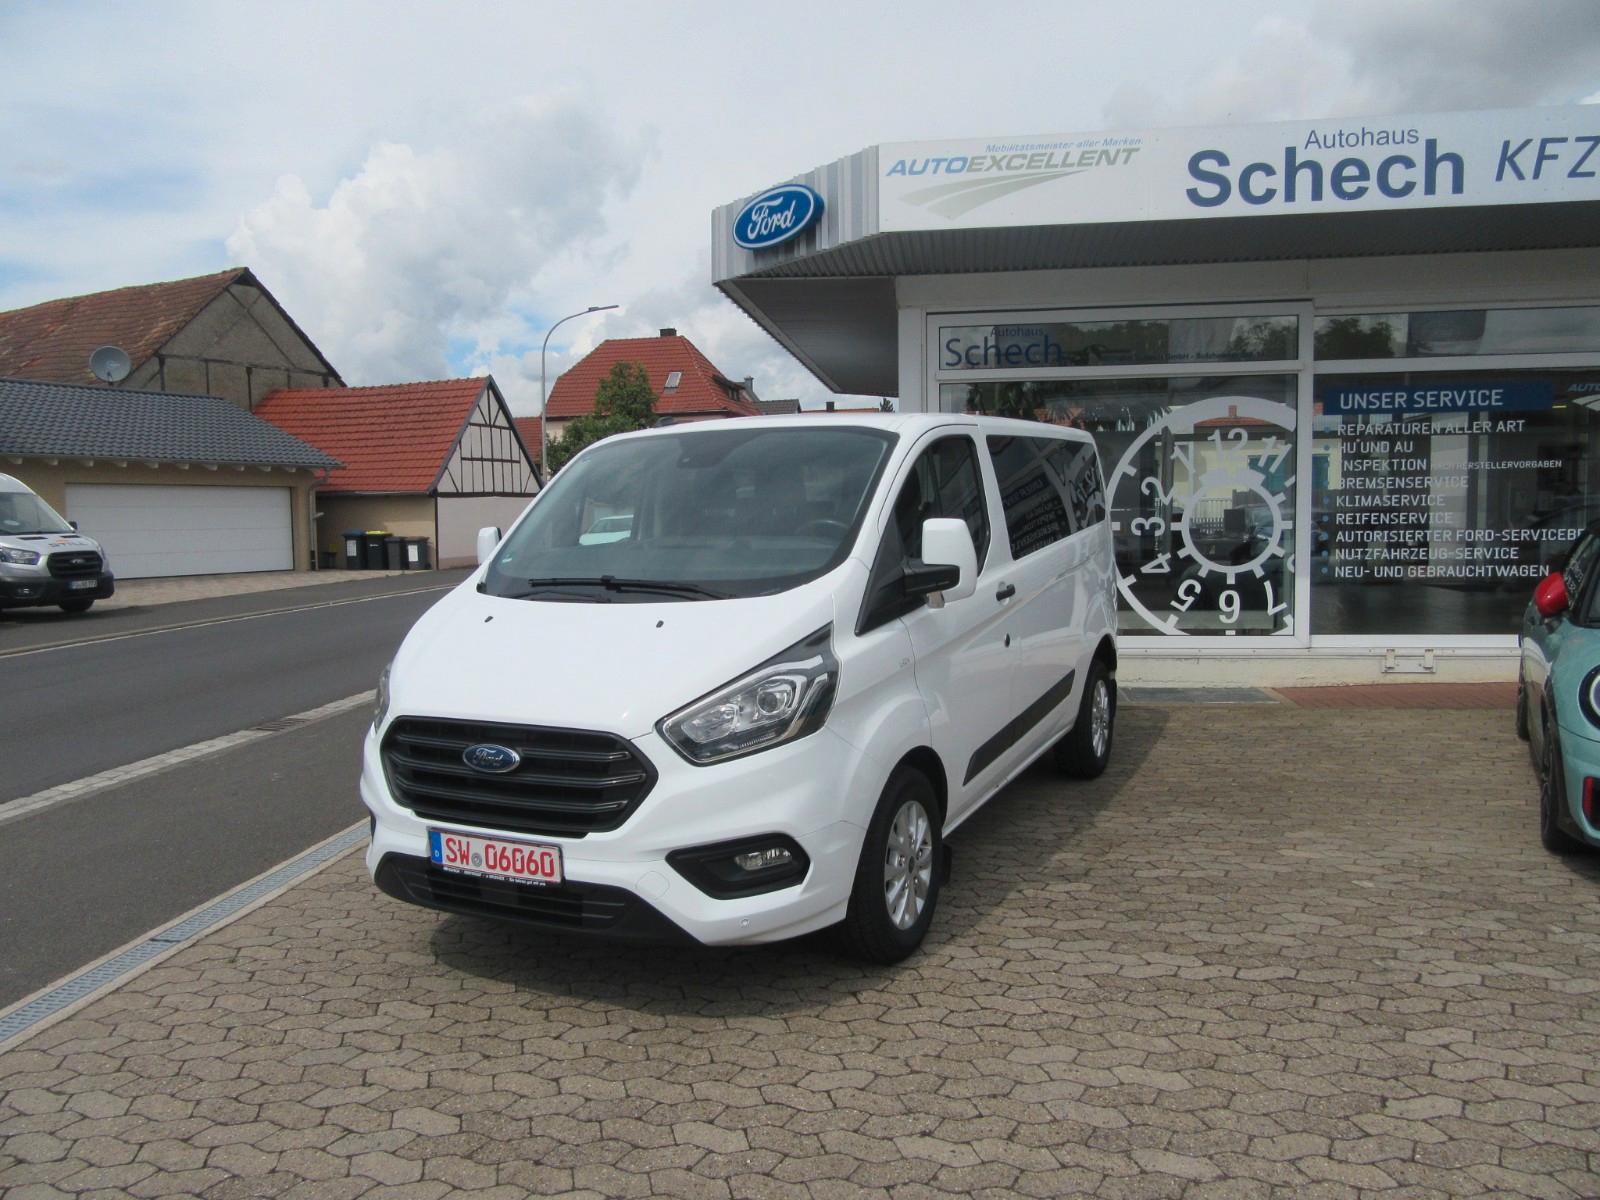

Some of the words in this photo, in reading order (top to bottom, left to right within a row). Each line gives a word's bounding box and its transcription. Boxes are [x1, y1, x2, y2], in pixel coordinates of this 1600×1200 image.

[1077, 139, 1100, 149] aller
[1304, 126, 1420, 151] Autohaus
[886, 147, 1140, 177] AUTOEXCELLENT
[1186, 138, 1465, 207] Schech
[1495, 135, 1600, 182] KFZ
[747, 196, 796, 240] Ford
[990, 326, 1045, 337] Autohaus
[945, 335, 1064, 367] Schech
[1340, 392, 1408, 410] UNSER
[1413, 389, 1504, 408] SERVICE
[1337, 422, 1441, 436] REPARATUREN
[1444, 421, 1493, 434] ALLER
[1496, 419, 1526, 432] ART
[1360, 440, 1390, 453] UND
[1393, 440, 1414, 452] AU
[1340, 458, 1427, 471] NSPEKTION
[1338, 475, 1469, 490] BREMSENSERVICE
[1336, 494, 1446, 507] KLIMASERVICE
[1335, 511, 1453, 525] REIFENSERVICE
[1335, 530, 1452, 543] AUTORISIERTER
[1335, 547, 1520, 560] NUTZFAHRZEUG-SERVICE
[1334, 565, 1371, 578] NEU-
[1374, 565, 1403, 578] UND
[1407, 564, 1550, 578] GEBRAUCHTWAGEN
[445, 837, 470, 865] SW
[484, 843, 555, 878] 06060
